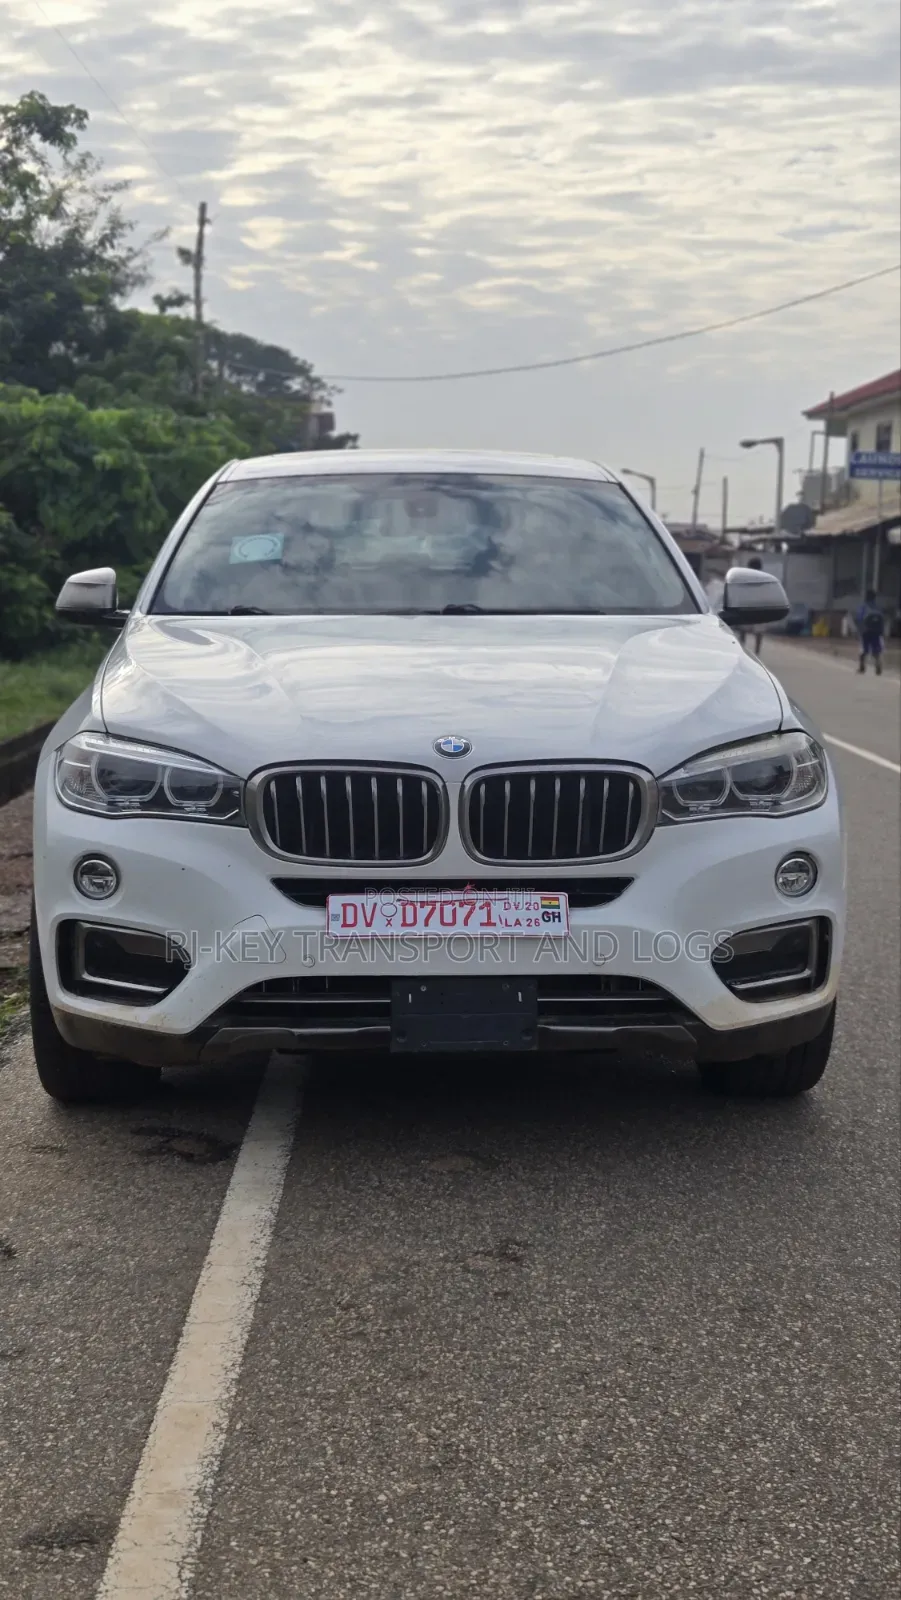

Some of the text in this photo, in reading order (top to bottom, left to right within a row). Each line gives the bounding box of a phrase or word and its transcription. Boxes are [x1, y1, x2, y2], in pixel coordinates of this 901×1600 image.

[503, 902, 540, 911] DV 20
[341, 902, 377, 928] DV
[400, 901, 497, 928] D7071
[541, 911, 562, 923] GH
[504, 918, 541, 928] LA 26
